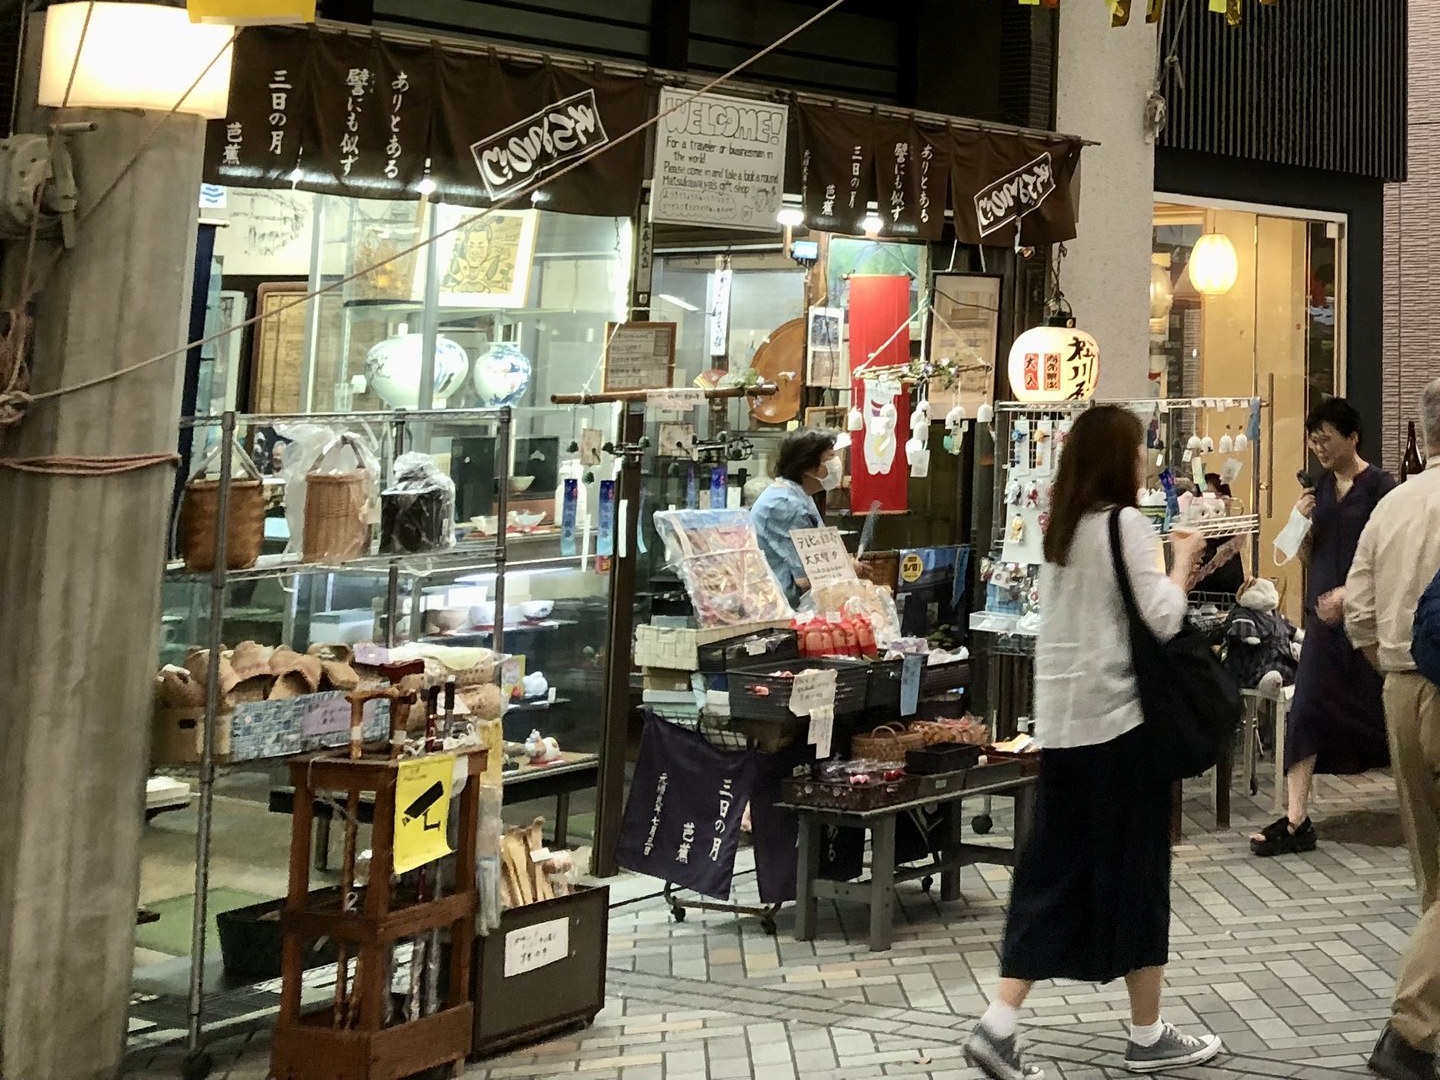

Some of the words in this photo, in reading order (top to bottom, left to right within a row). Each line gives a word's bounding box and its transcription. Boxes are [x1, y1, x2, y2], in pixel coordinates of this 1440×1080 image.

[268, 69, 292, 155] 三日の月
[383, 71, 409, 179] ありとある
[664, 97, 784, 145] WELCOME!
[222, 121, 243, 165] 芭蕉
[665, 136, 679, 149] For
[681, 140, 687, 149] a
[674, 151, 685, 162] the
[663, 161, 686, 175] Please
[687, 166, 703, 176] come
[713, 167, 723, 178] and
[719, 181, 732, 195] gift
[848, 145, 863, 209] 三日の月
[919, 143, 933, 223] ありとある
[821, 184, 836, 216] 芭蕉
[708, 779, 733, 862] 三日の月
[675, 822, 696, 864] 芭蕉
